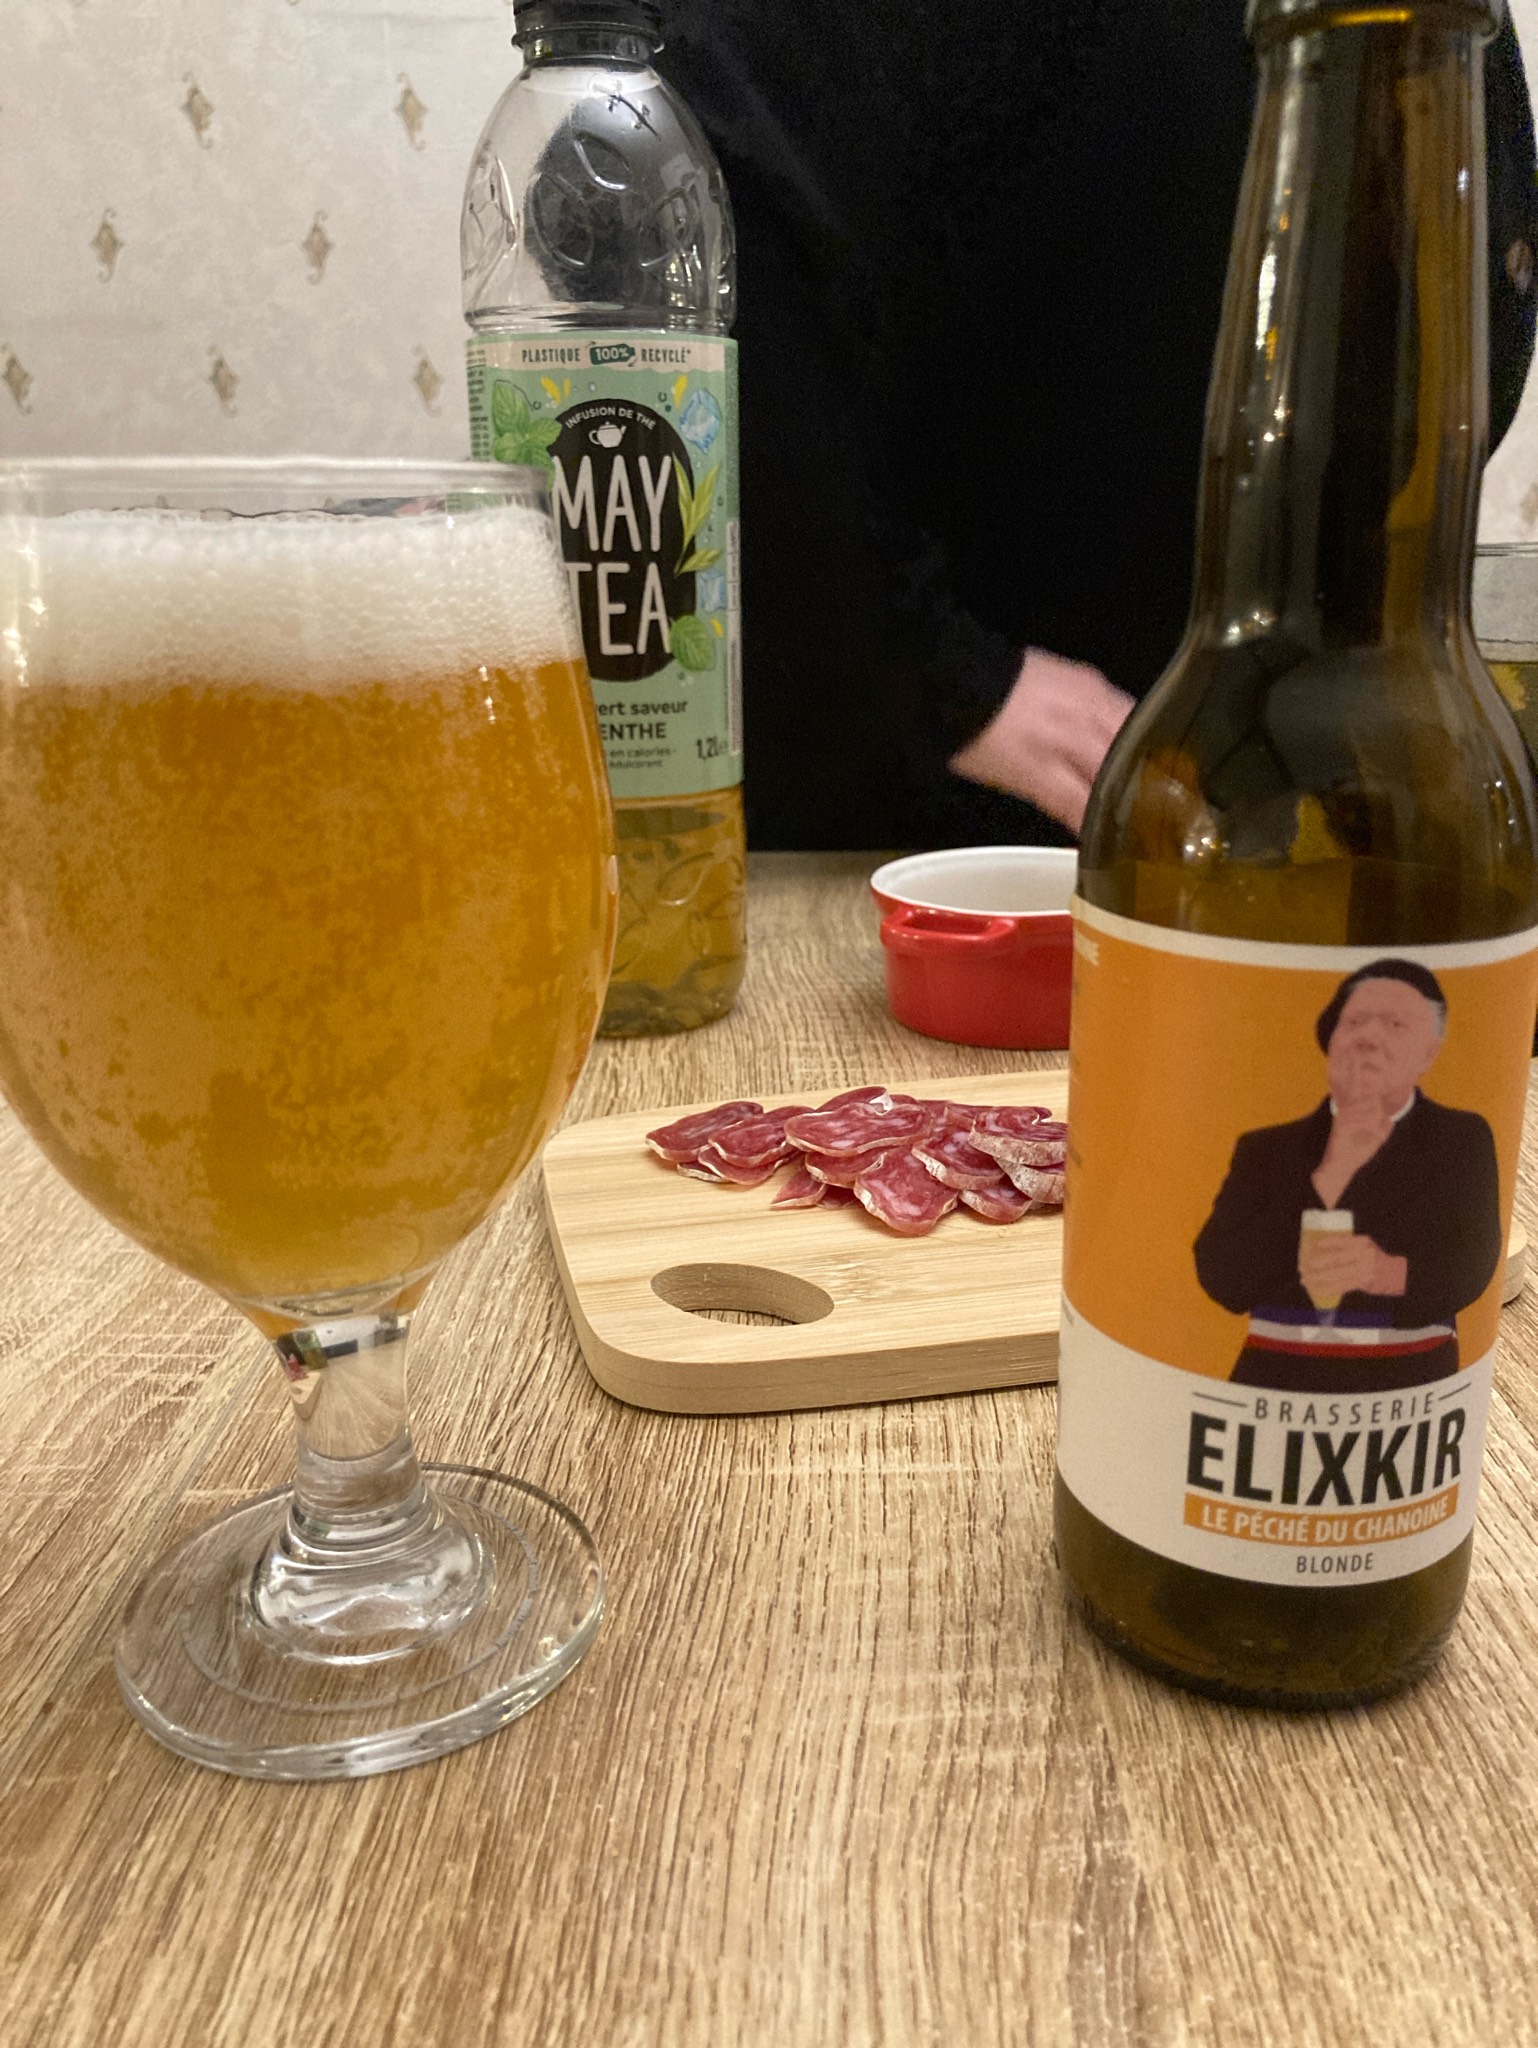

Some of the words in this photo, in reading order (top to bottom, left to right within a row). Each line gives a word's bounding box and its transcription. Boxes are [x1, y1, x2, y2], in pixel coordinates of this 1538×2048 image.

[522, 348, 581, 364] PLASTIQUE
[595, 347, 630, 361] 100%
[565, 407, 616, 429] INFUSION
[618, 408, 634, 419] DE
[552, 455, 672, 552] MAY
[564, 562, 672, 656] TEA
[595, 702, 626, 716] ert
[630, 701, 689, 716] saveur
[599, 722, 668, 741] ENTHE
[1255, 1391, 1434, 1426] BRASSERIE
[1187, 1407, 1467, 1506] ELIXKIR
[1202, 1504, 1230, 1530] LE
[1234, 1511, 1309, 1543] PÉCHÉ
[1314, 1519, 1349, 1543] DU
[1353, 1495, 1449, 1541] CHANOINE
[1297, 1552, 1375, 1574] BLONDE
